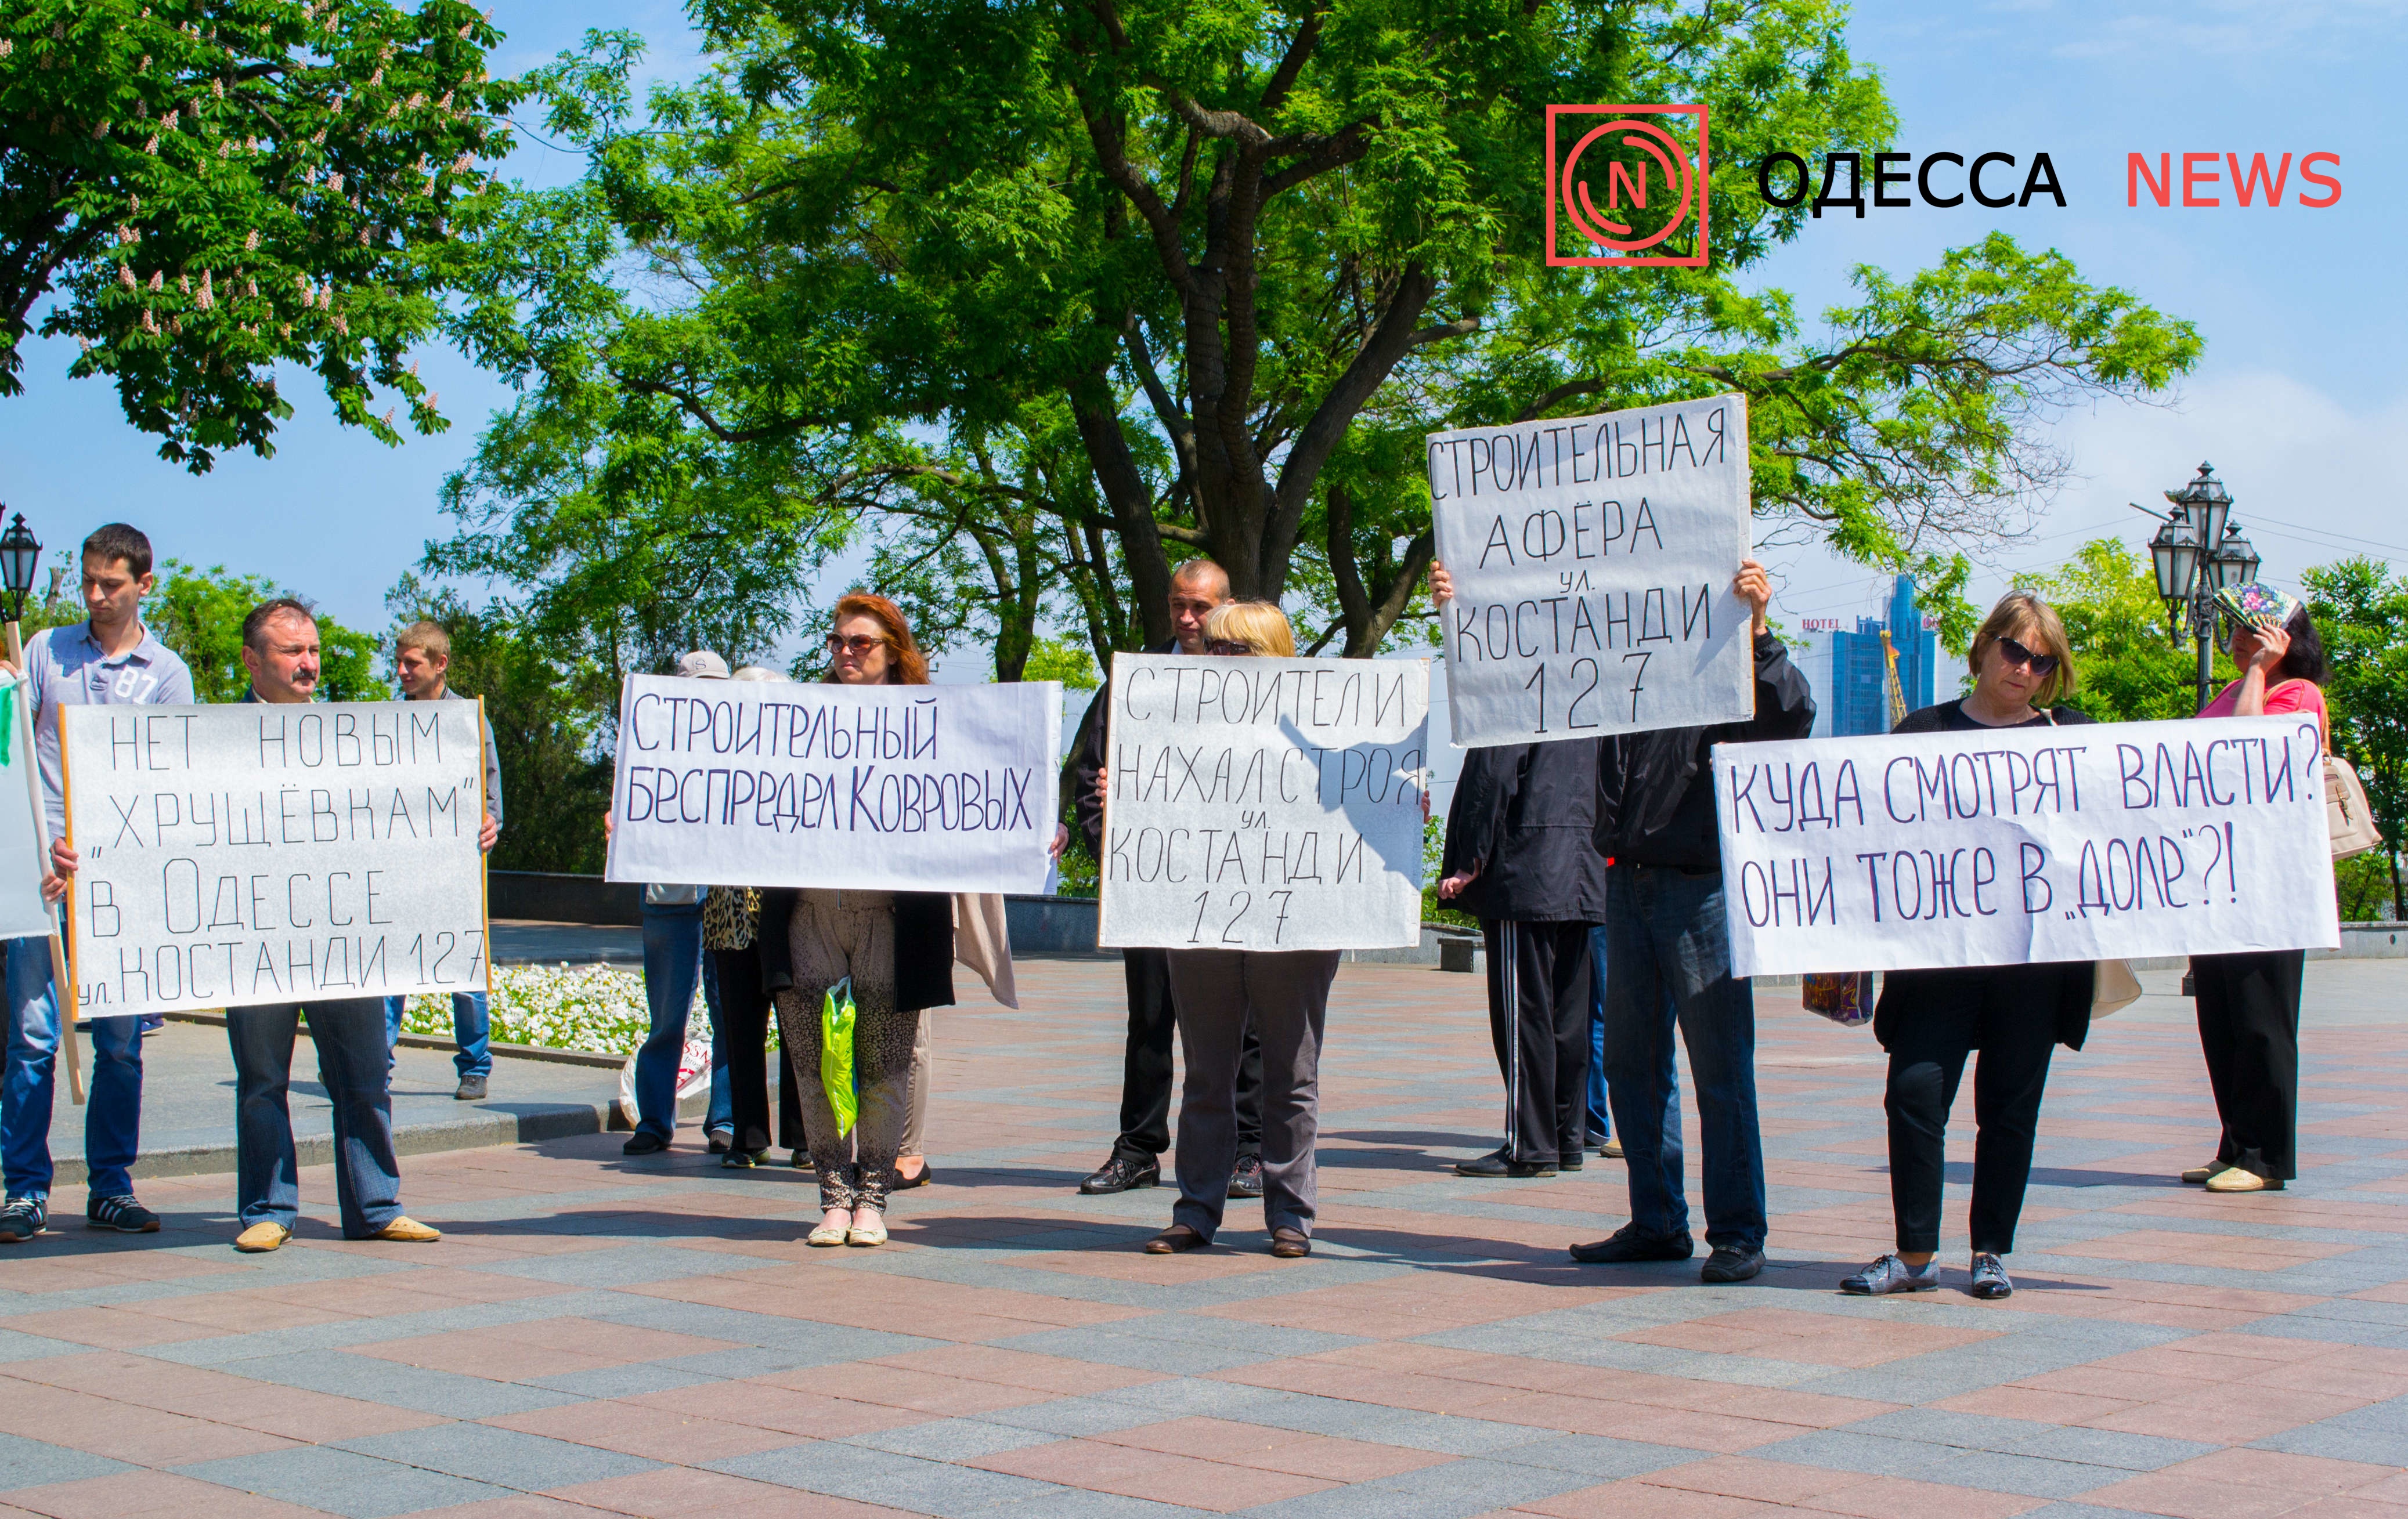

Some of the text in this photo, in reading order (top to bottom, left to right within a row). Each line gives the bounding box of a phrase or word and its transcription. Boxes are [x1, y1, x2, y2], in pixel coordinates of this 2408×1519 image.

[1428, 407, 1725, 501] СТРОИТЕЛЬНАЯ
[1478, 497, 1663, 570] АФЁРА
[1559, 569, 1596, 594] ул.
[1456, 583, 1711, 663] КОСТАНДИ
[1802, 618, 1841, 630] HOTEL
[114, 667, 158, 704] 87
[1126, 667, 1405, 728] СТРОИТЕЛИ
[1524, 651, 1653, 735] 127
[111, 713, 442, 771] НЕТ НОВЫМ
[631, 692, 938, 761] СТРОИТЕЛЬНЫЙ
[627, 765, 1032, 834] БЕСПРЕДЕЛ КОВРОВЫХ
[1730, 724, 2321, 834] КУДА СМОТРЯТ ВЛАСТИ?
[1240, 810, 1271, 830] ул.
[1109, 827, 1363, 885] КОСТАНДИ
[1741, 856, 1836, 928] ОНИ
[1857, 845, 1998, 923] ТОЖЕ
[2019, 841, 2053, 914] В
[91, 858, 393, 938] В ОДЕССЕ
[1186, 890, 1294, 945] 127
[77, 930, 485, 1007] ул. КОСТАНДИ 127
